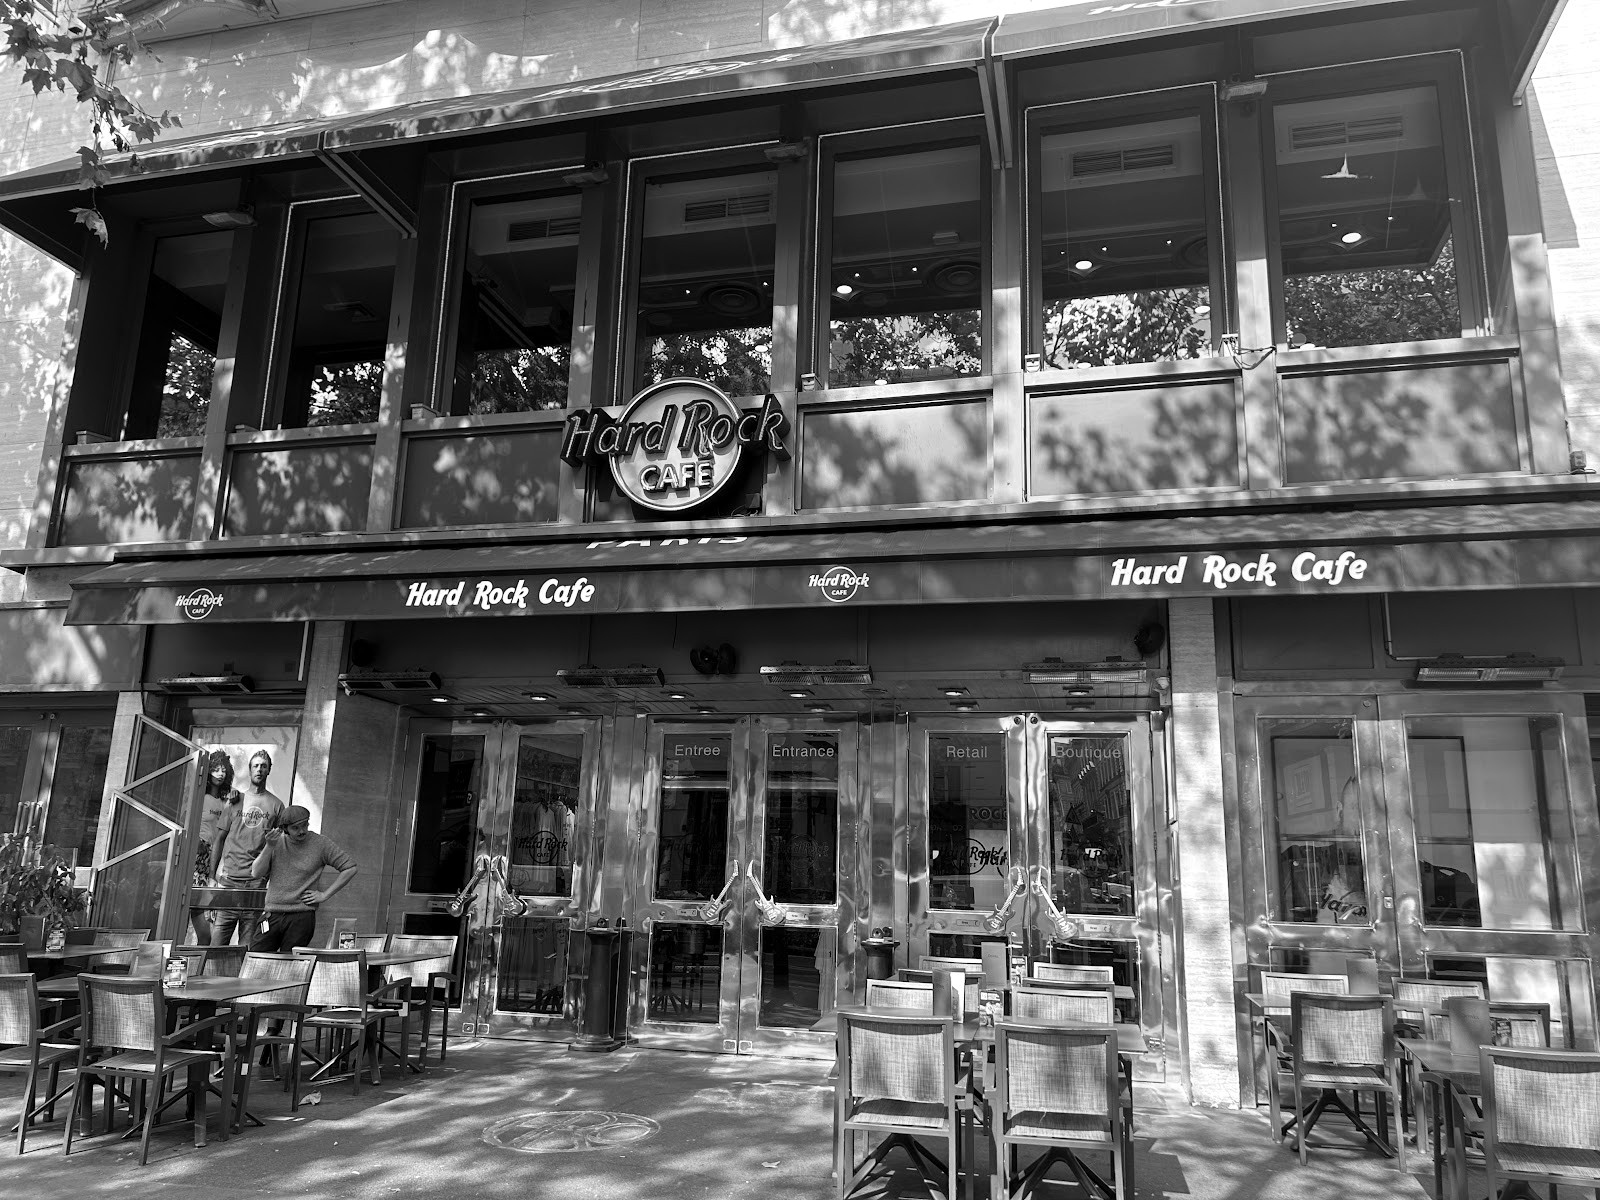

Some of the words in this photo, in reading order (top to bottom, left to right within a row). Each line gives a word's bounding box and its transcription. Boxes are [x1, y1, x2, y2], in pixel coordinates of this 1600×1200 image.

[560, 404, 678, 467] Hard
[678, 393, 791, 461] Rock
[640, 462, 715, 492] CAFE
[1110, 556, 1188, 586] Hard
[1202, 553, 1277, 589] Rock
[1291, 551, 1368, 585] Cafe
[808, 574, 840, 587] Hard
[840, 573, 870, 588] Rock
[175, 595, 201, 607] Hard
[200, 594, 224, 607] Rock
[405, 581, 465, 606] Hard
[473, 579, 529, 610] Rock
[538, 577, 595, 607] Cafe
[674, 744, 721, 756] Entree
[772, 745, 835, 757] Entrance
[946, 745, 988, 758] Retail
[1055, 746, 1122, 759] Boutique
